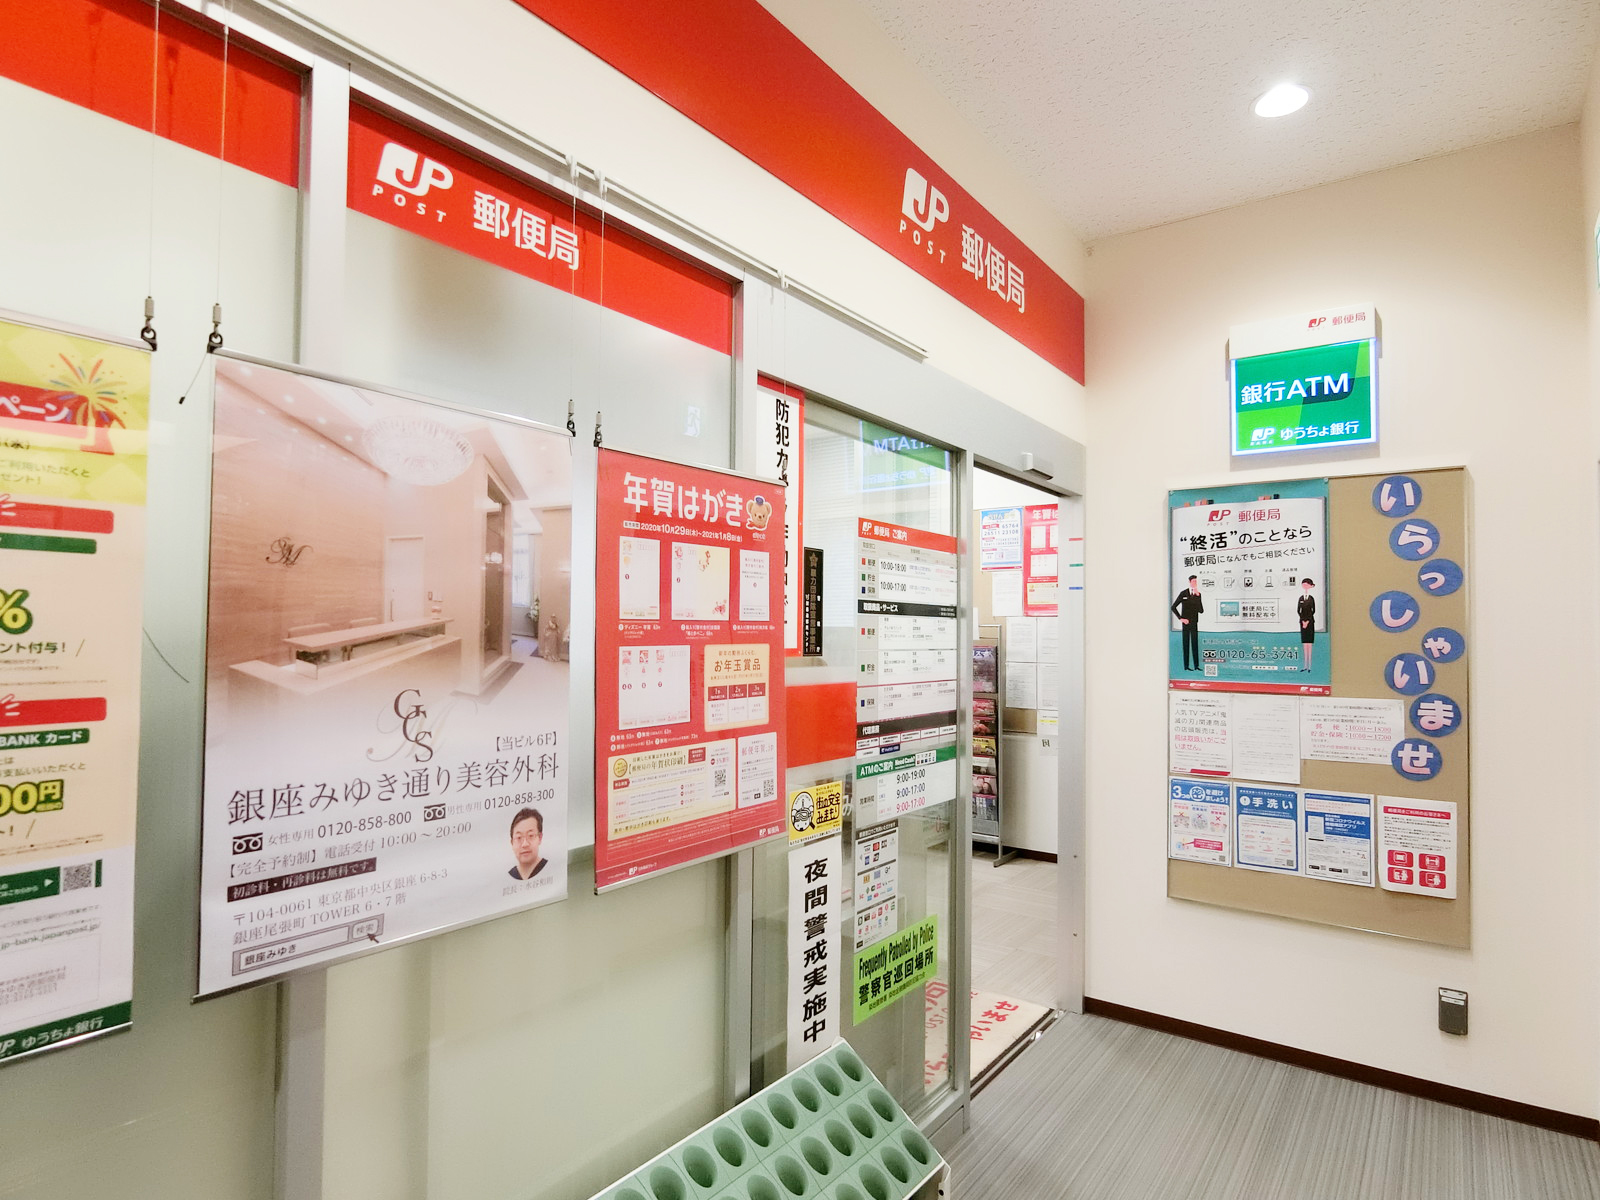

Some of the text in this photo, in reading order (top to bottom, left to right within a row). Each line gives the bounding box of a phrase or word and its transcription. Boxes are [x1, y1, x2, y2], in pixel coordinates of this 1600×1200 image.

[372, 184, 446, 222] POST
[473, 190, 579, 270] 郵便局
[900, 220, 946, 263] POST
[961, 224, 1025, 313] 郵便局
[1332, 312, 1366, 326] 郵便局
[1241, 373, 1349, 405] 銀行ATM
[1280, 421, 1359, 441] ゆうちょ銀行
[624, 472, 743, 527] 年賀はがき
[1238, 508, 1280, 522] 郵便局
[1183, 547, 1315, 567] 郵便局になんでもご相談ください
[715, 659, 760, 672] お年玉賞品
[1219, 650, 1298, 660] 0120-65-3741
[45, 730, 83, 743] カード
[227, 752, 559, 826] 銀座みゆき通り美容外科
[897, 769, 925, 784] 9:00-19:00
[897, 782, 925, 799] 9:00-17:00
[318, 810, 412, 838] 0120-858-800
[484, 788, 555, 810] 0120-858-300
[896, 796, 925, 813] 9:00-17:00
[1252, 797, 1293, 809] 手洗い
[229, 850, 317, 878] 【完全予約制】
[324, 838, 375, 859] 電話受付
[232, 918, 306, 946] 銀座尾張町
[310, 902, 361, 925] TOWER
[244, 944, 297, 966] 銀座みゆき
[803, 858, 828, 1043] 夜間警戒実施中
[859, 923, 934, 980] Frequently Patrolled by Police
[859, 946, 933, 1006] 警察官巡回場所
[22, 1016, 104, 1048] ゆうちょ銀行
